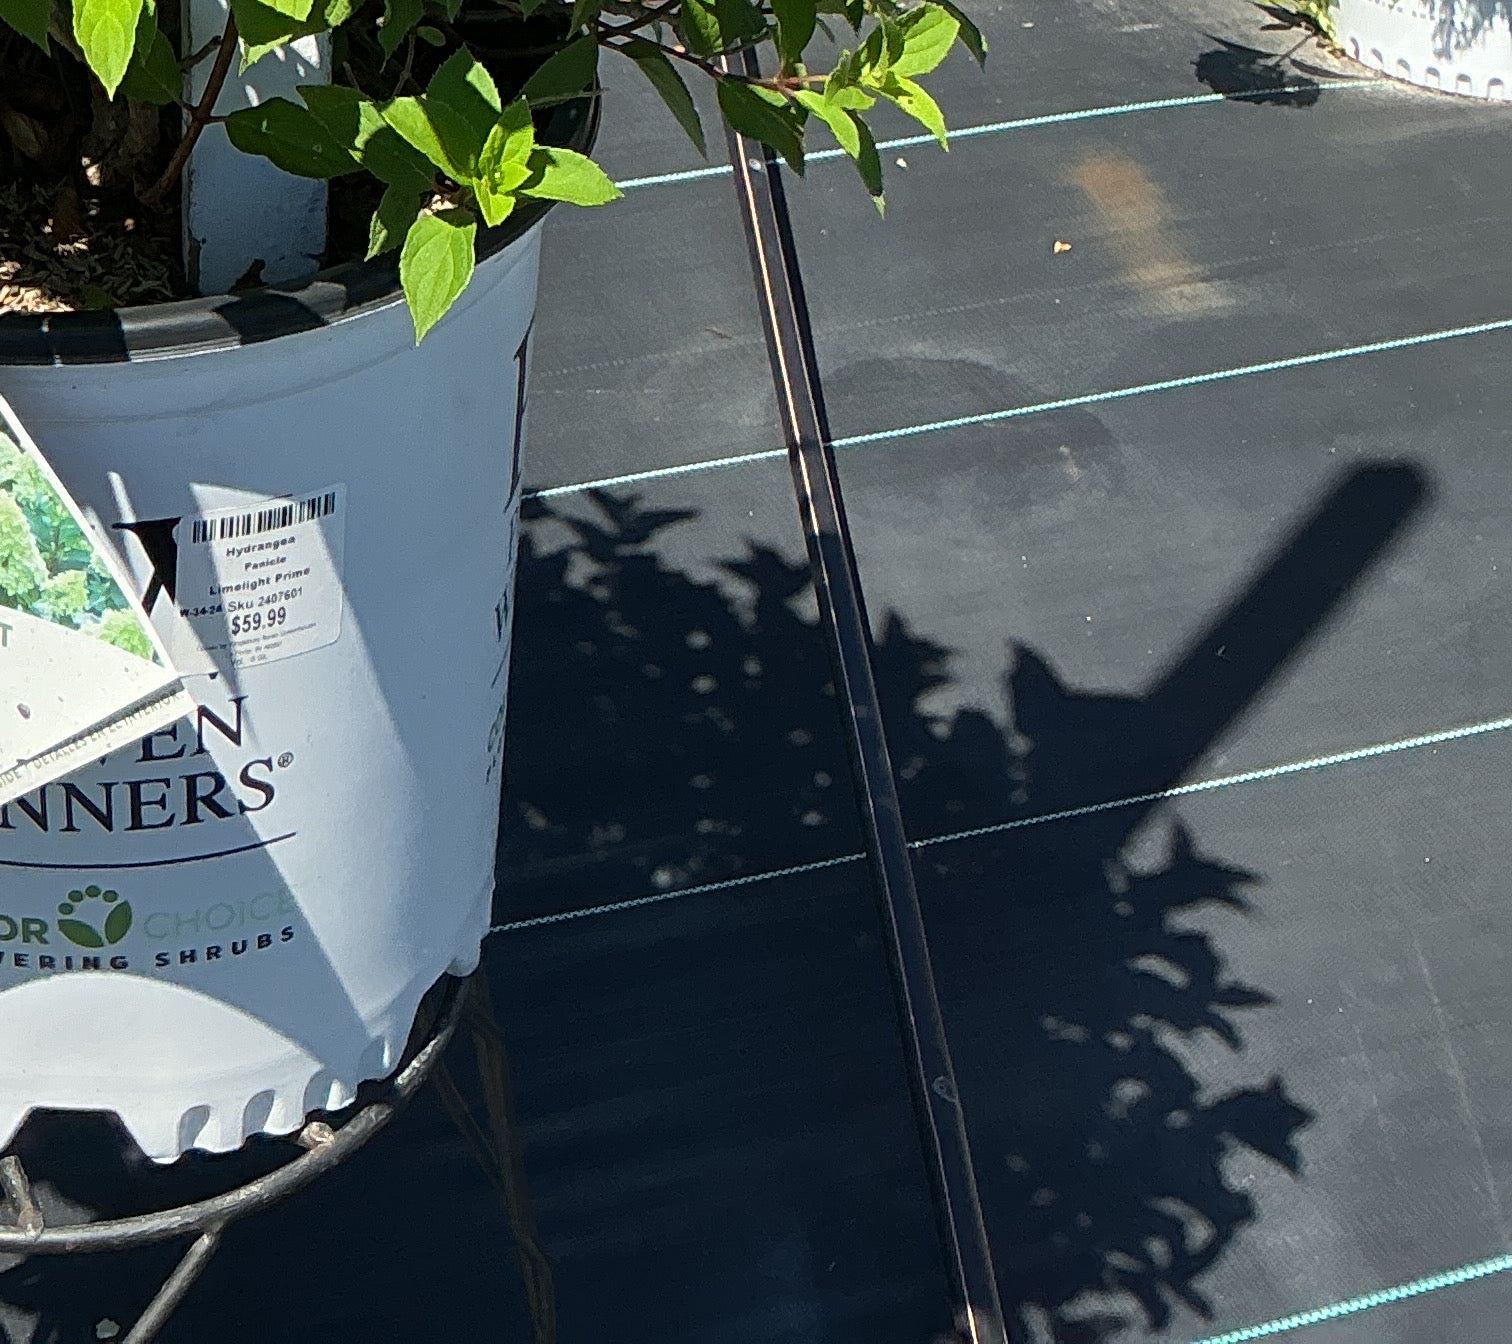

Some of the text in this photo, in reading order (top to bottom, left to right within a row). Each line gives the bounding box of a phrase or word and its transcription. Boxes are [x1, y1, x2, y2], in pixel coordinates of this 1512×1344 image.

[226, 535, 296, 558] Hydrangea
[244, 556, 287, 572] Panicle
[209, 566, 311, 596] Limelight Prime
[227, 586, 304, 613] Sku 2407601
[231, 606, 287, 636] $59.99
[154, 925, 296, 969] SHRUBS
